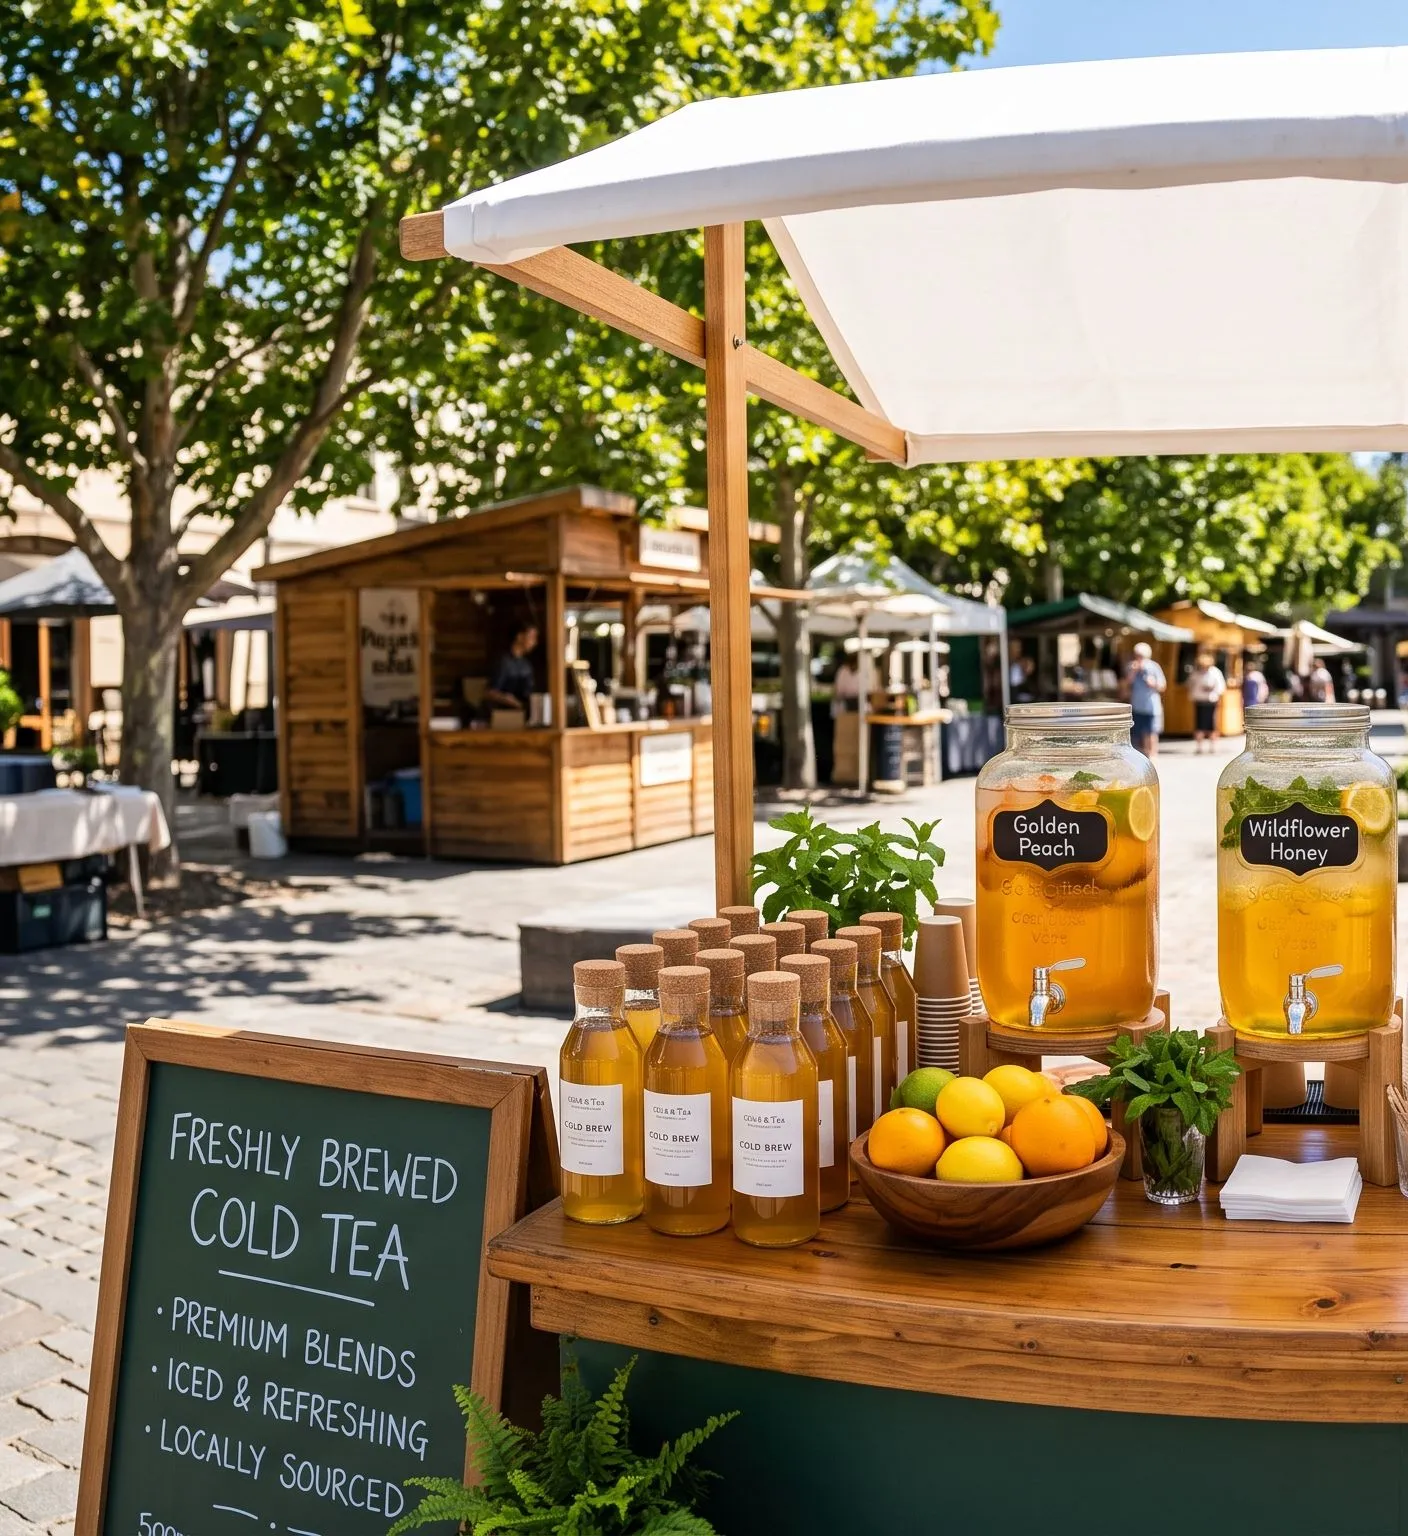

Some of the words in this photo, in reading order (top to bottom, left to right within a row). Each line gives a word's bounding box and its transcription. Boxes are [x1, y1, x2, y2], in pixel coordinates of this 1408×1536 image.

[1013, 815, 1080, 835] Golden
[1248, 818, 1350, 838] Wildflower
[1019, 837, 1075, 857] Peach
[1270, 842, 1328, 866] Honey
[585, 1124, 613, 1133] BREW
[649, 1130, 669, 1141] COLD
[672, 1134, 700, 1143] BREW
[739, 1140, 761, 1151] COLD
[764, 1143, 793, 1152] BREW
[171, 1112, 301, 1181] FRESHLY
[319, 1138, 458, 1204] BREWED
[190, 1187, 300, 1260] COLD
[321, 1213, 410, 1291] TEA
[171, 1296, 288, 1359] PREMIUM
[304, 1328, 416, 1388] BLENDS
[168, 1357, 224, 1401] ICED
[233, 1375, 251, 1412] &
[263, 1381, 429, 1462] REFRESHING
[160, 1418, 266, 1480] LOCALLY
[279, 1453, 404, 1518] SOURCED
